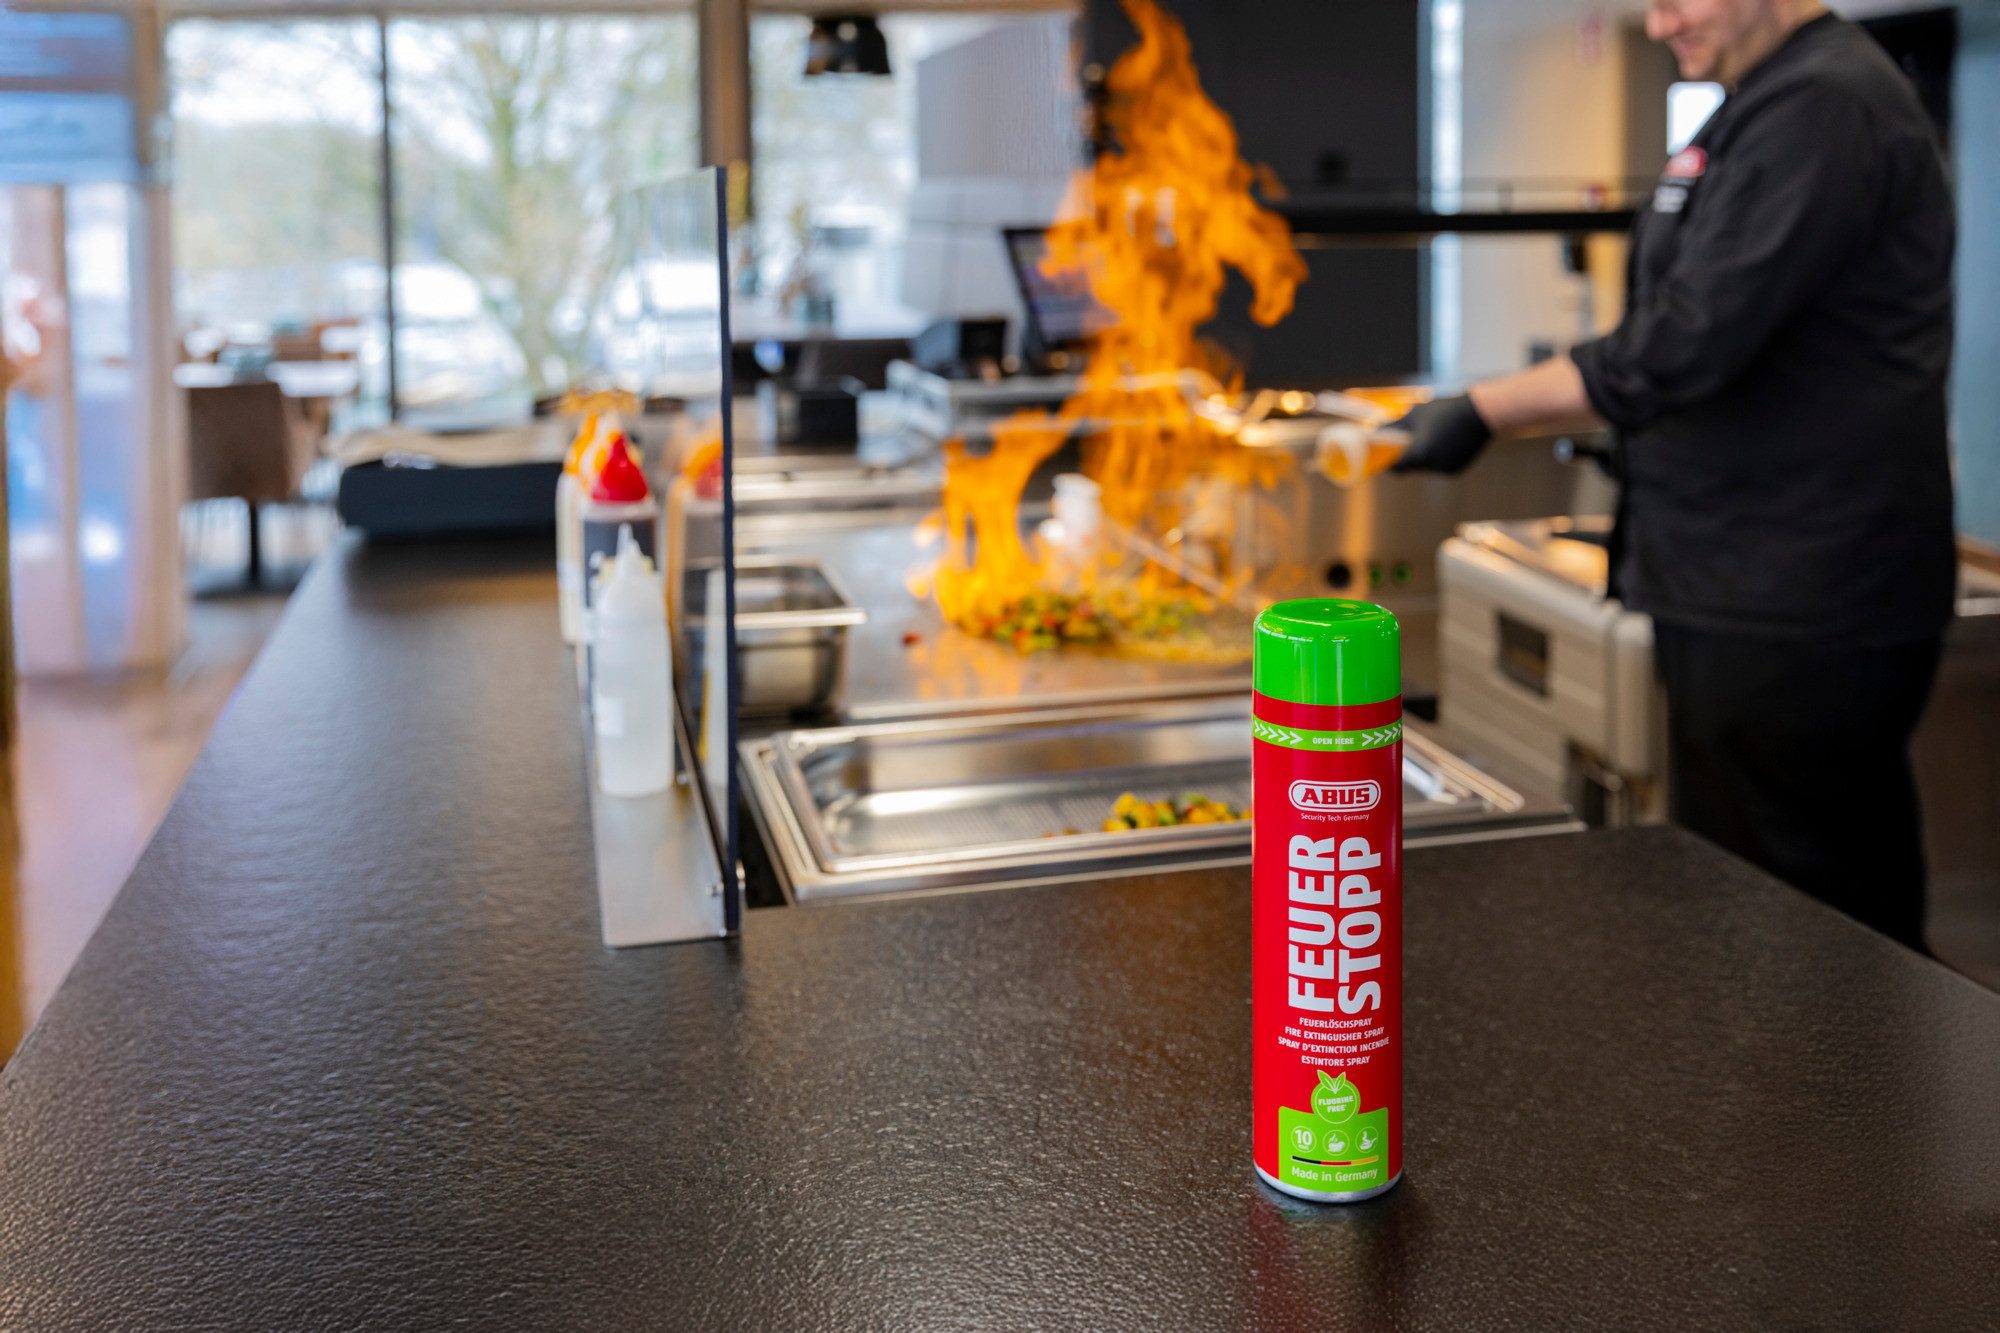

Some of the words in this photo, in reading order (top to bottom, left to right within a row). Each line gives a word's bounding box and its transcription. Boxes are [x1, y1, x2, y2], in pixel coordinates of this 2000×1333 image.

[1312, 737, 1333, 745] OPEN
[1335, 737, 1354, 745] HERE
[1301, 787, 1370, 805] ABUS
[1301, 813, 1326, 822] Security
[1327, 814, 1341, 822] Tech
[1343, 813, 1370, 822] Germany
[1288, 834, 1335, 1012] FEUER
[1337, 836, 1382, 1014] STOPP
[1299, 1017, 1373, 1029] FEUERLÖSCHSPRAY
[1284, 1026, 1302, 1038] FIRE
[1303, 1030, 1362, 1042] EXTINGUISHER
[1363, 1026, 1385, 1039] SPRAY
[1278, 1036, 1300, 1050] SPRAY
[1360, 1036, 1390, 1051] INCENDIE
[1301, 1055, 1345, 1067] ESTINTORE
[1346, 1055, 1371, 1067] SPRAY
[1295, 1129, 1313, 1146] 10
[1291, 1166, 1318, 1180] Made
[1321, 1171, 1332, 1181] in
[1335, 1168, 1378, 1182] Germany
